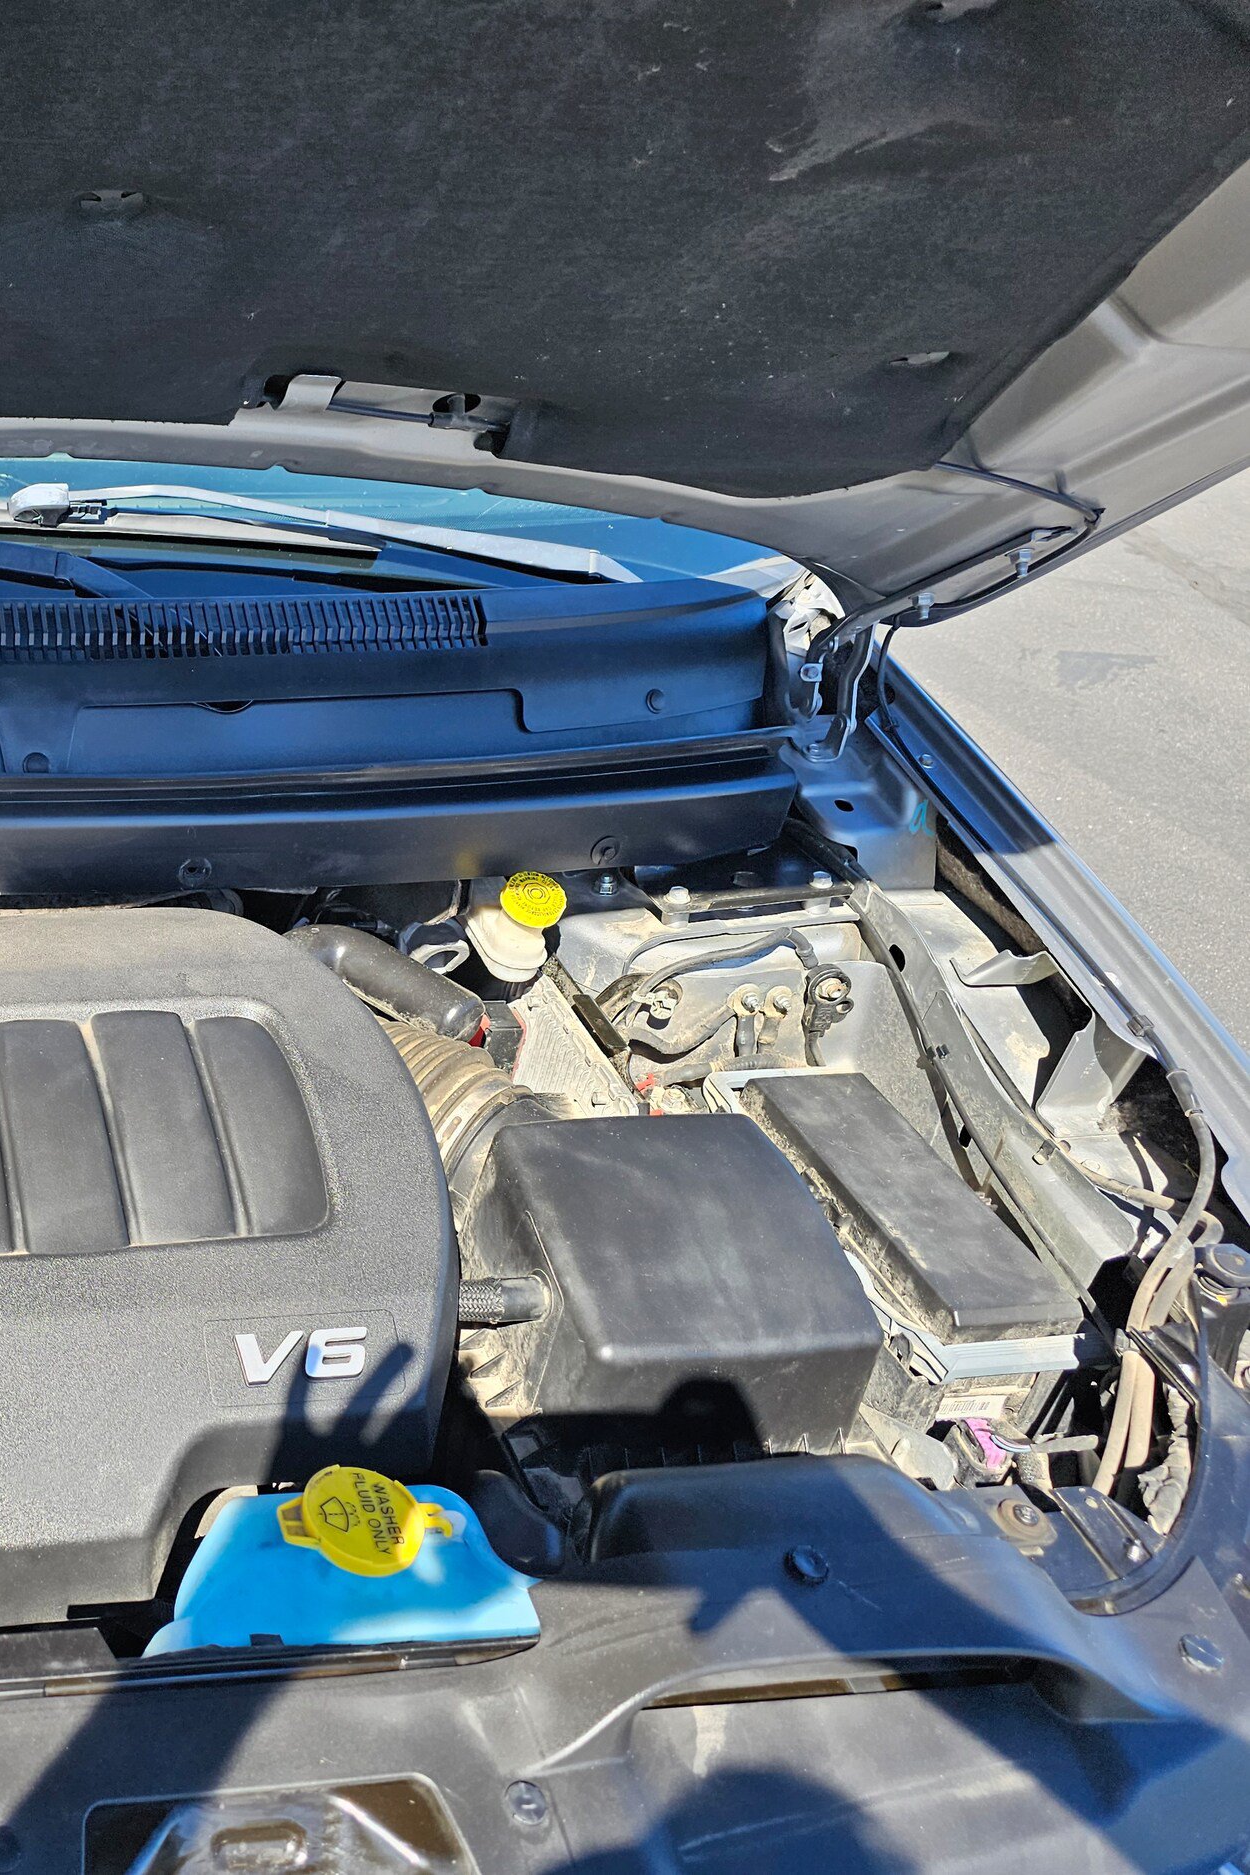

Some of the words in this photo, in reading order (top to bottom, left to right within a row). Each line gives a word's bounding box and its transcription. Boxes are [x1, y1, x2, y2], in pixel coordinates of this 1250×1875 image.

[233, 1326, 368, 1387] V6
[352, 1472, 376, 1513] FLUID
[367, 1518, 391, 1556] ONLY
[372, 1483, 405, 1545] WASHER
